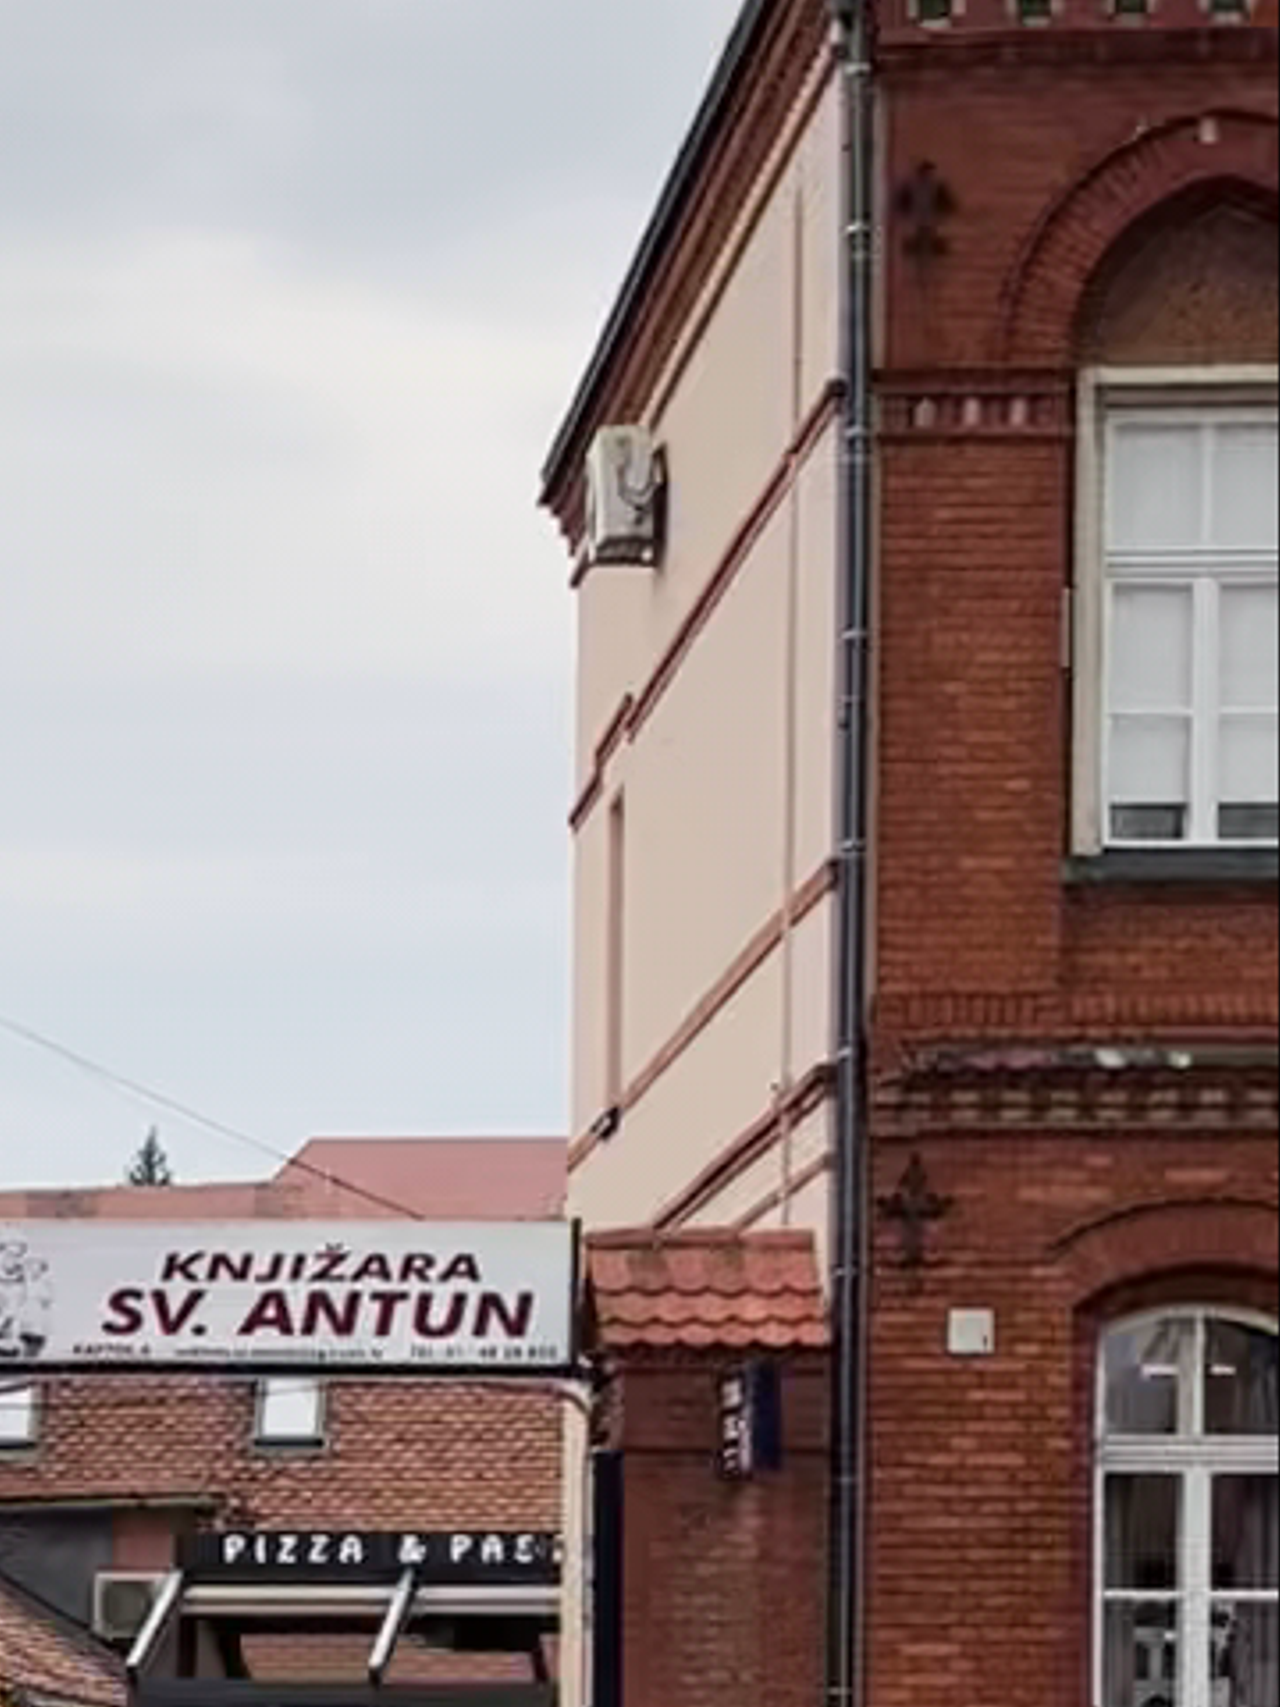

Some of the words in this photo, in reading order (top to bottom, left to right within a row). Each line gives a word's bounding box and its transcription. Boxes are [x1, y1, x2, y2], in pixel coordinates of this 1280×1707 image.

[161, 1243, 480, 1282] KNJIŽARA
[101, 1289, 207, 1336] SV.
[237, 1290, 534, 1336] ANTUN
[224, 1534, 364, 1564] PIZZA
[398, 1534, 427, 1564] &
